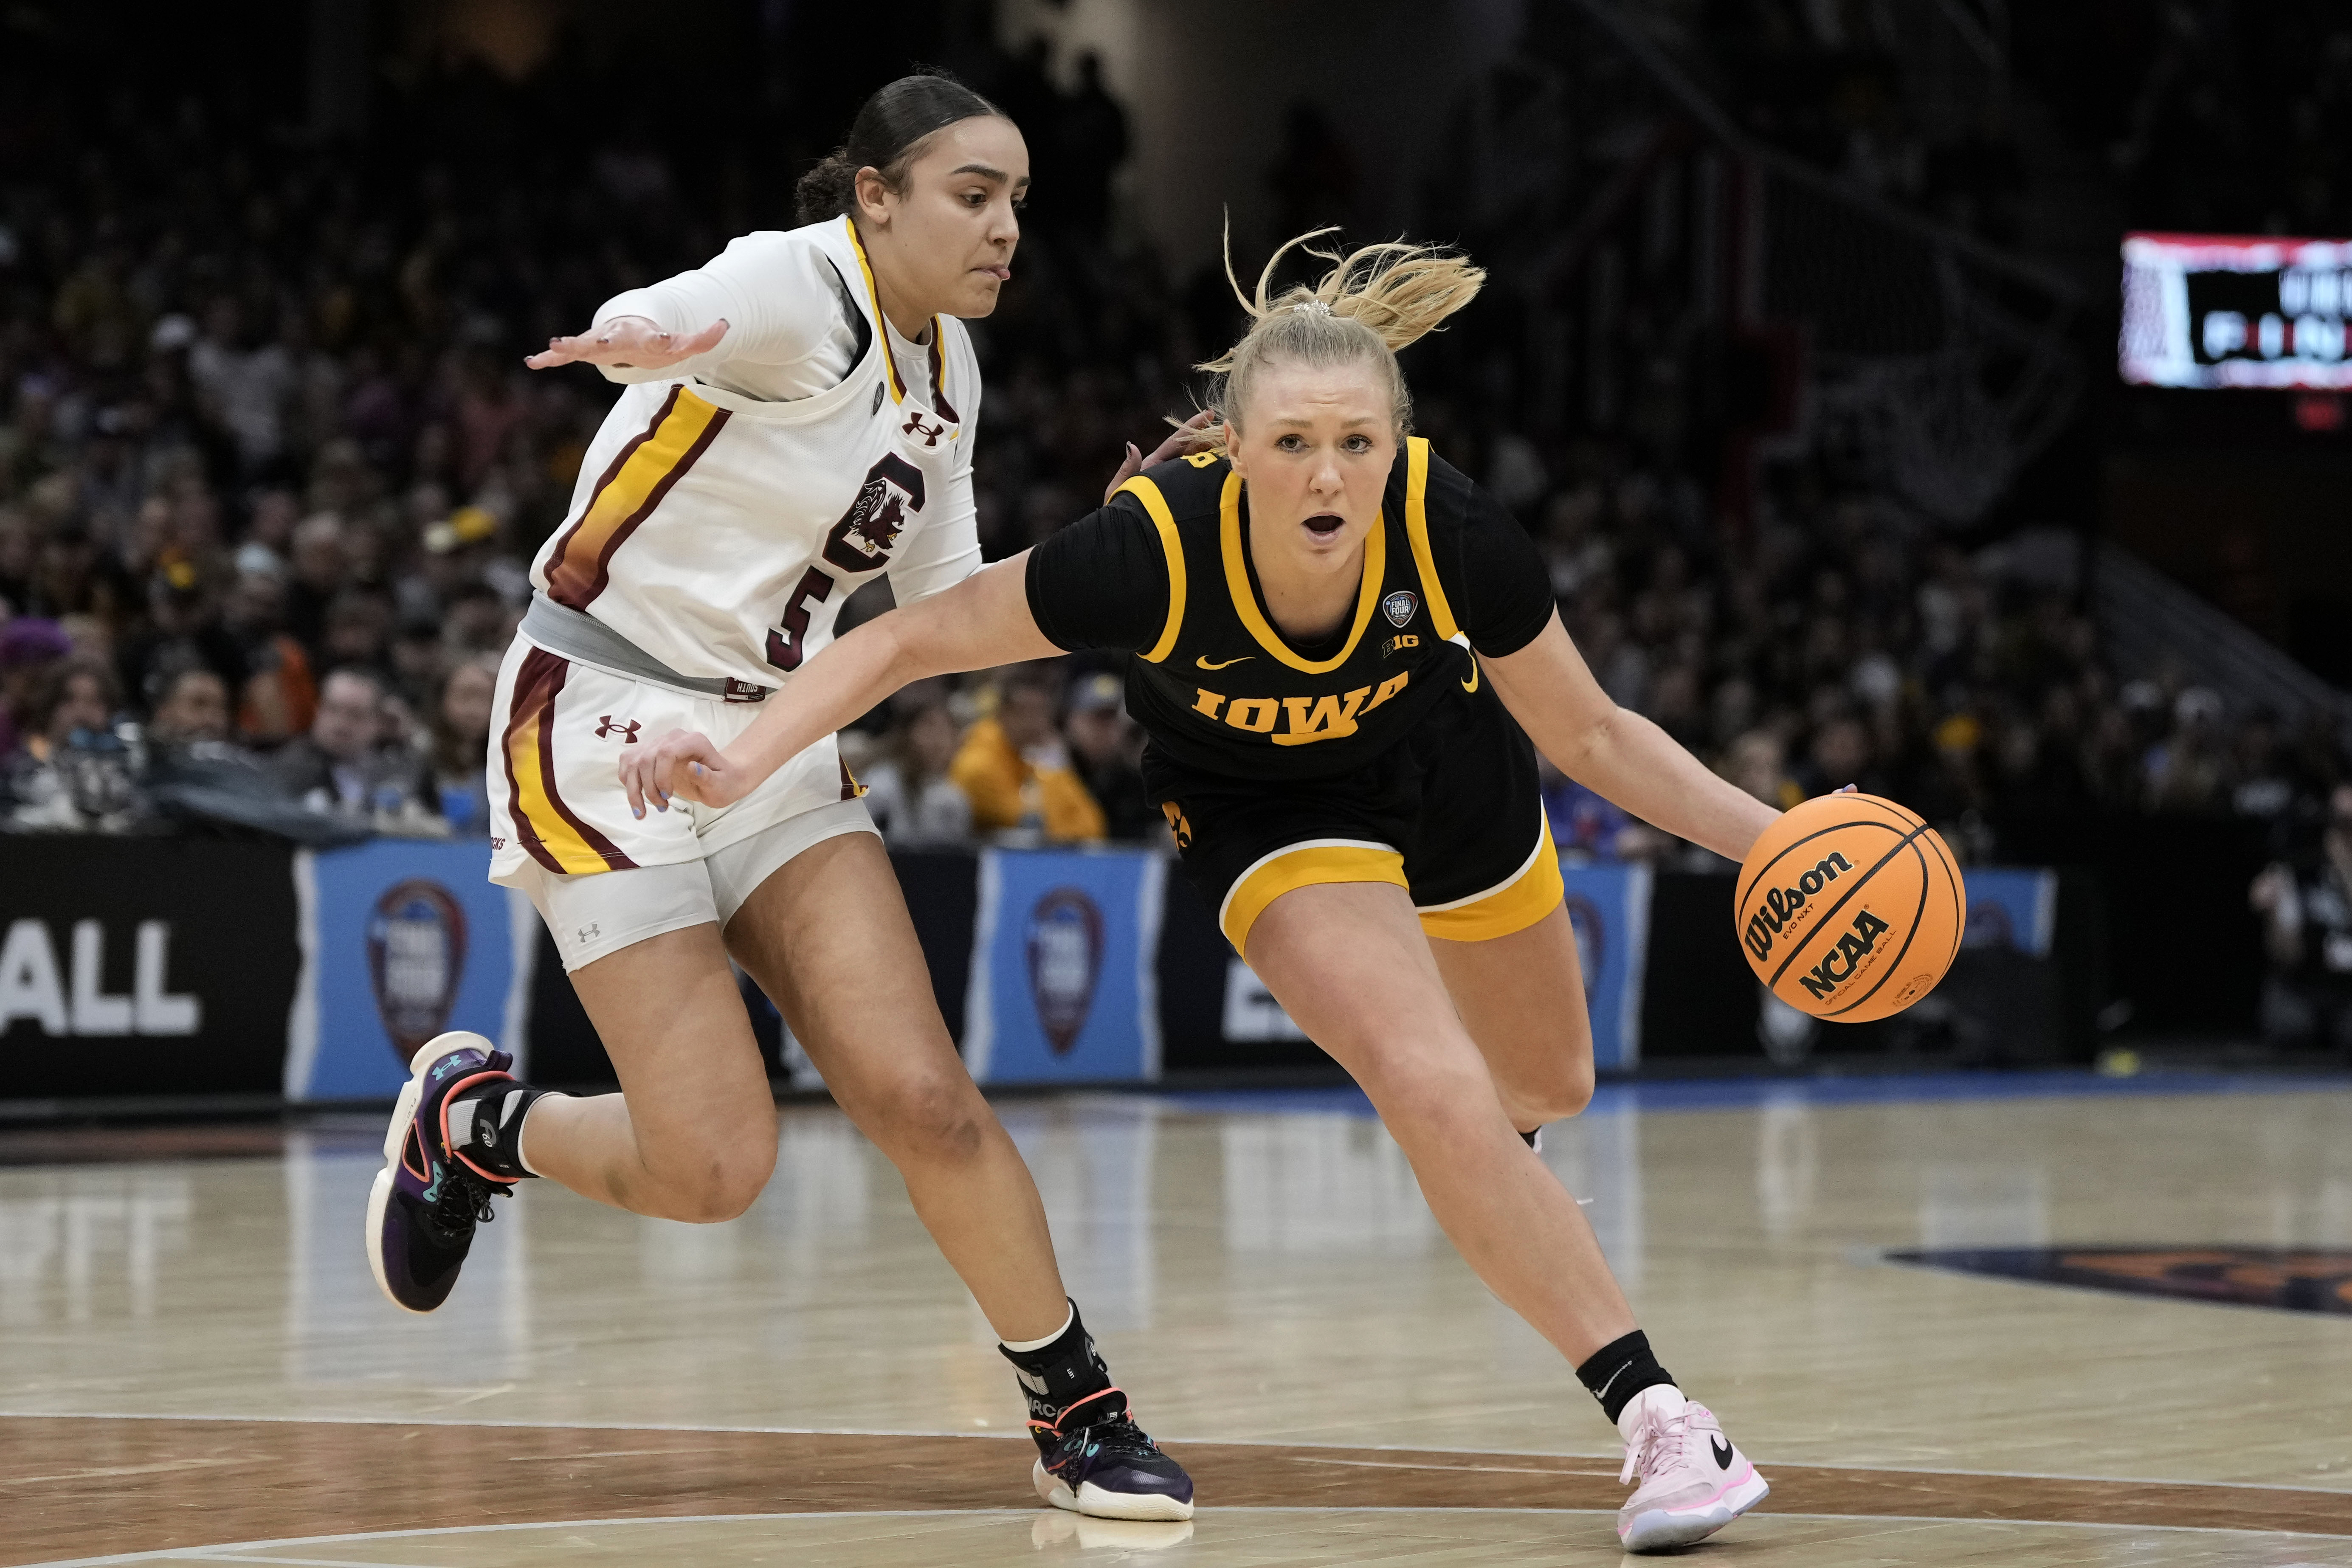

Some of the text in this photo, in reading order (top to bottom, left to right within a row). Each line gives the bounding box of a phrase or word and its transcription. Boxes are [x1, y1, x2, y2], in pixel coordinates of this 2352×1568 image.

[765, 565, 835, 673] 5
[1391, 599, 1409, 608] FINAL
[1391, 606, 1409, 615] FOUR
[737, 682, 759, 693] SOUTH
[1191, 671, 1408, 734] IOWA
[1744, 850, 1855, 962] Wilson
[1783, 903, 1814, 940] EVO NXT
[0, 917, 203, 1037] ALL
[1798, 909, 1890, 1001] NCAA
[1825, 929, 1897, 1006] OFFICIAL GAME BALL
[1067, 1368, 1075, 1379] LEFT
